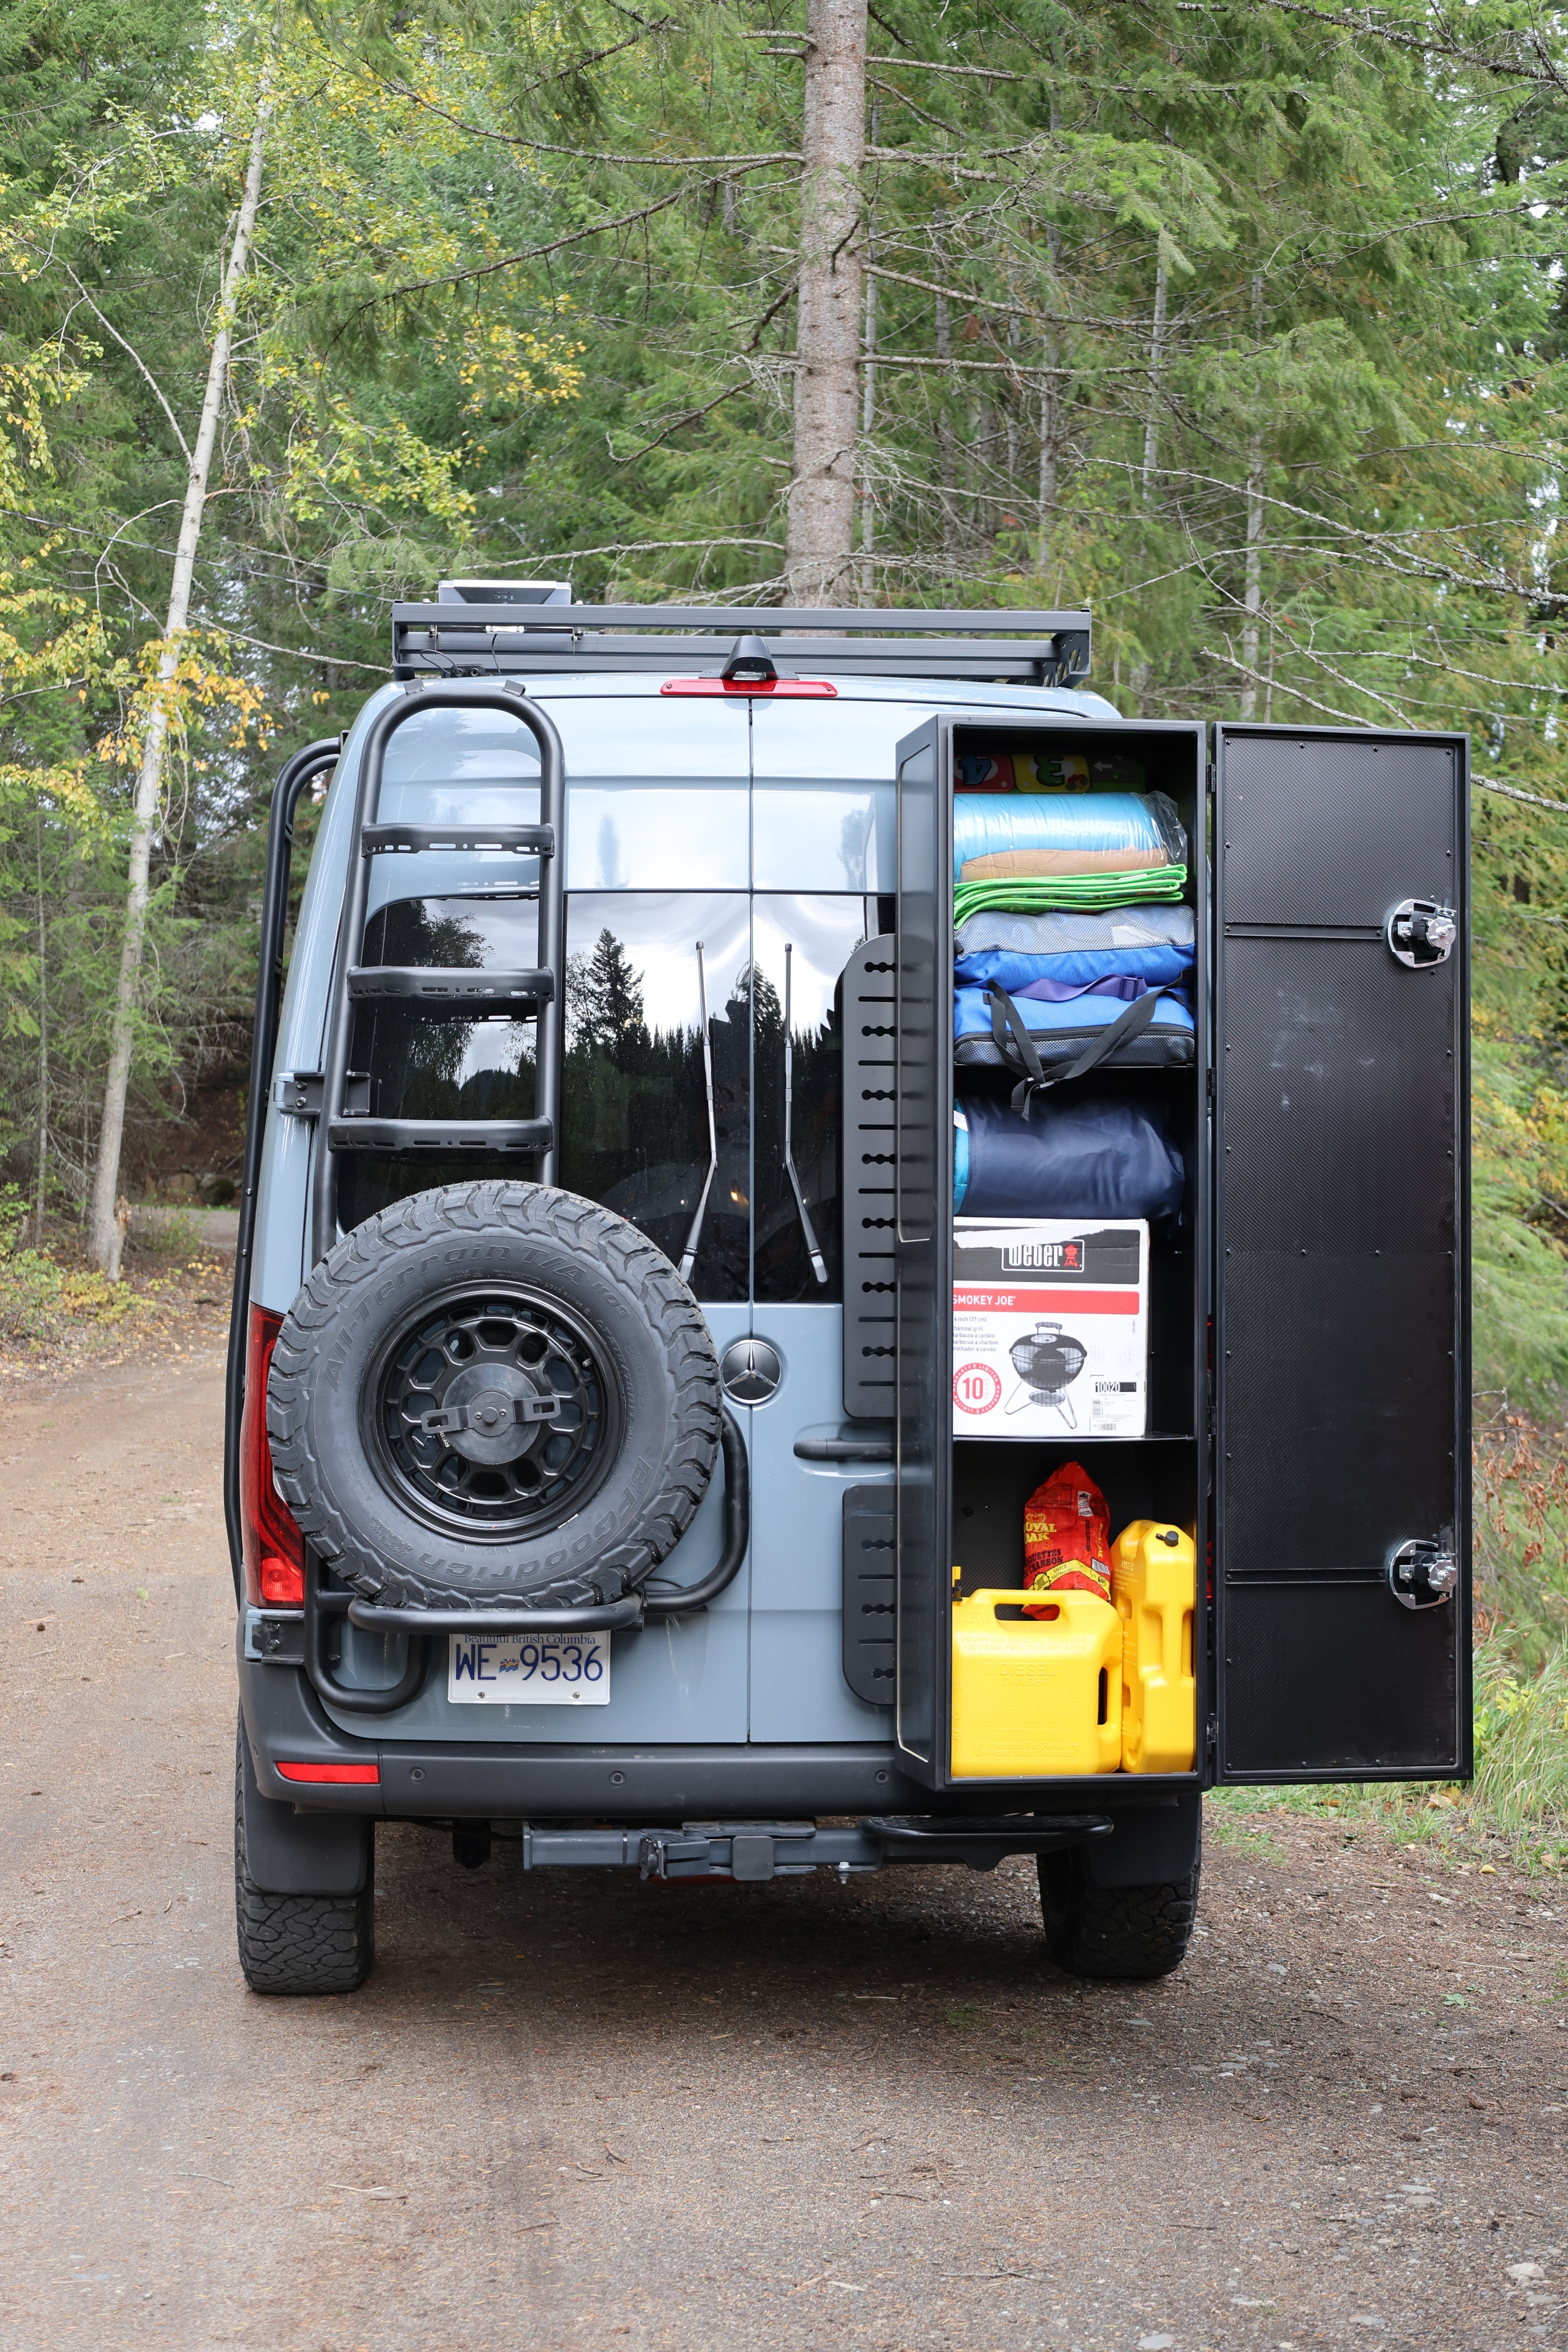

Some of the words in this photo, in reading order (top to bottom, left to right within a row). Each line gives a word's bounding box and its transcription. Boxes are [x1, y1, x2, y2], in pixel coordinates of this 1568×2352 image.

[953, 1295, 993, 1305] SMOKEY
[326, 1243, 511, 1392] All-Terrain
[523, 1245, 587, 1285] T/A
[979, 1365, 998, 1382] LIMITED
[962, 1377, 983, 1399] 10
[1095, 1381, 1120, 1392] 10020
[981, 1385, 1000, 1412] WARRANTY
[417, 1456, 653, 1583] BFGoodrich
[512, 1634, 544, 1644] British
[546, 1634, 595, 1644] Columbia
[456, 1644, 497, 1680] WE
[520, 1644, 603, 1681] 9536
[1000, 1662, 1055, 1676] DIESEL
